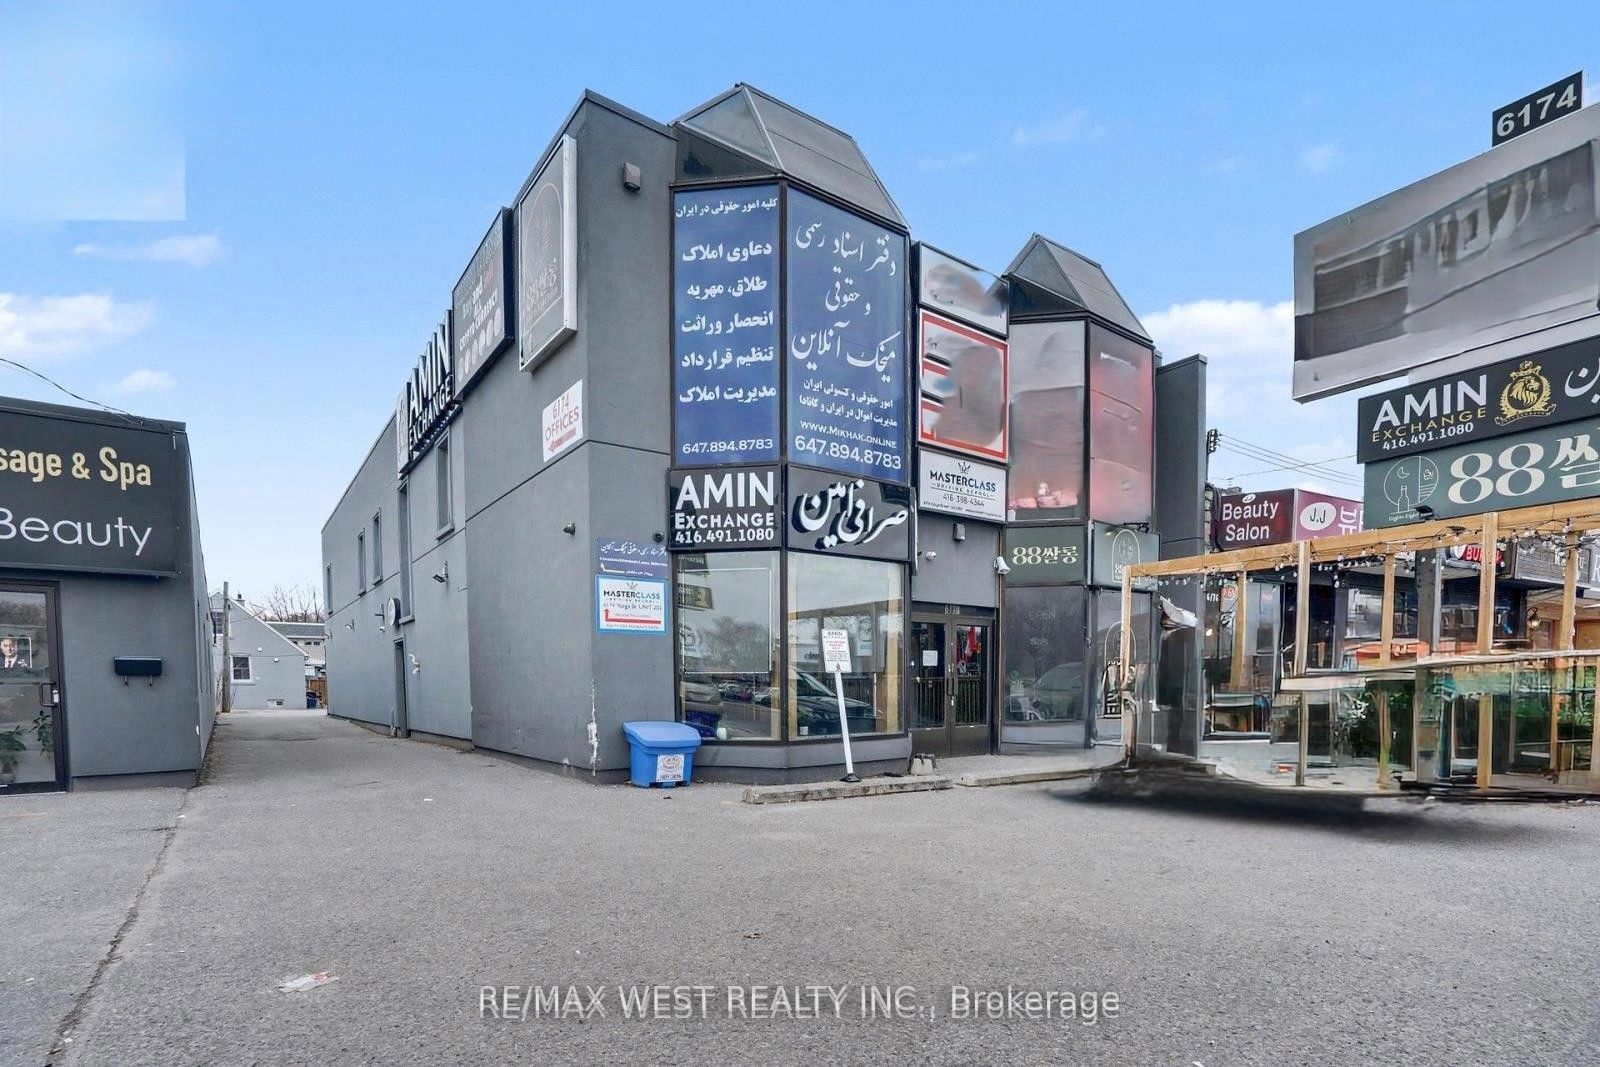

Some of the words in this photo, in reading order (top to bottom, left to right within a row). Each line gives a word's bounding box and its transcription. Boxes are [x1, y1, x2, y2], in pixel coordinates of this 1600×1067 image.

[1496, 83, 1577, 137] 6174
[682, 243, 724, 261] املاک
[727, 240, 773, 263] دعاوی
[687, 283, 724, 301] مهریه
[681, 314, 722, 335] وراثت
[726, 309, 774, 334] انحصار
[681, 347, 733, 371] قرارداد
[736, 347, 774, 369] تنظیم
[408, 310, 452, 429] AMIN
[679, 385, 720, 402] املاک
[723, 385, 776, 403] مدیریت
[1373, 374, 1488, 432] AMIN
[545, 406, 579, 441] OFFICES
[1372, 408, 1487, 443] EXCHANGE
[682, 438, 774, 454] 647.894.8783
[1382, 422, 1475, 451] 416.491.1080
[794, 435, 902, 470] 647.894.8783
[71, 452, 91, 480] &
[99, 446, 152, 491] Spa
[675, 471, 774, 511] AMIN
[930, 470, 996, 492] MASTERCLASS
[674, 512, 774, 530] EXCHANGE
[1222, 500, 1279, 521] Beauty
[0, 507, 152, 556] Beauty
[675, 528, 774, 544] 416.491.1080
[1225, 523, 1270, 541] Salon
[603, 590, 661, 600] MASTERCLASS
